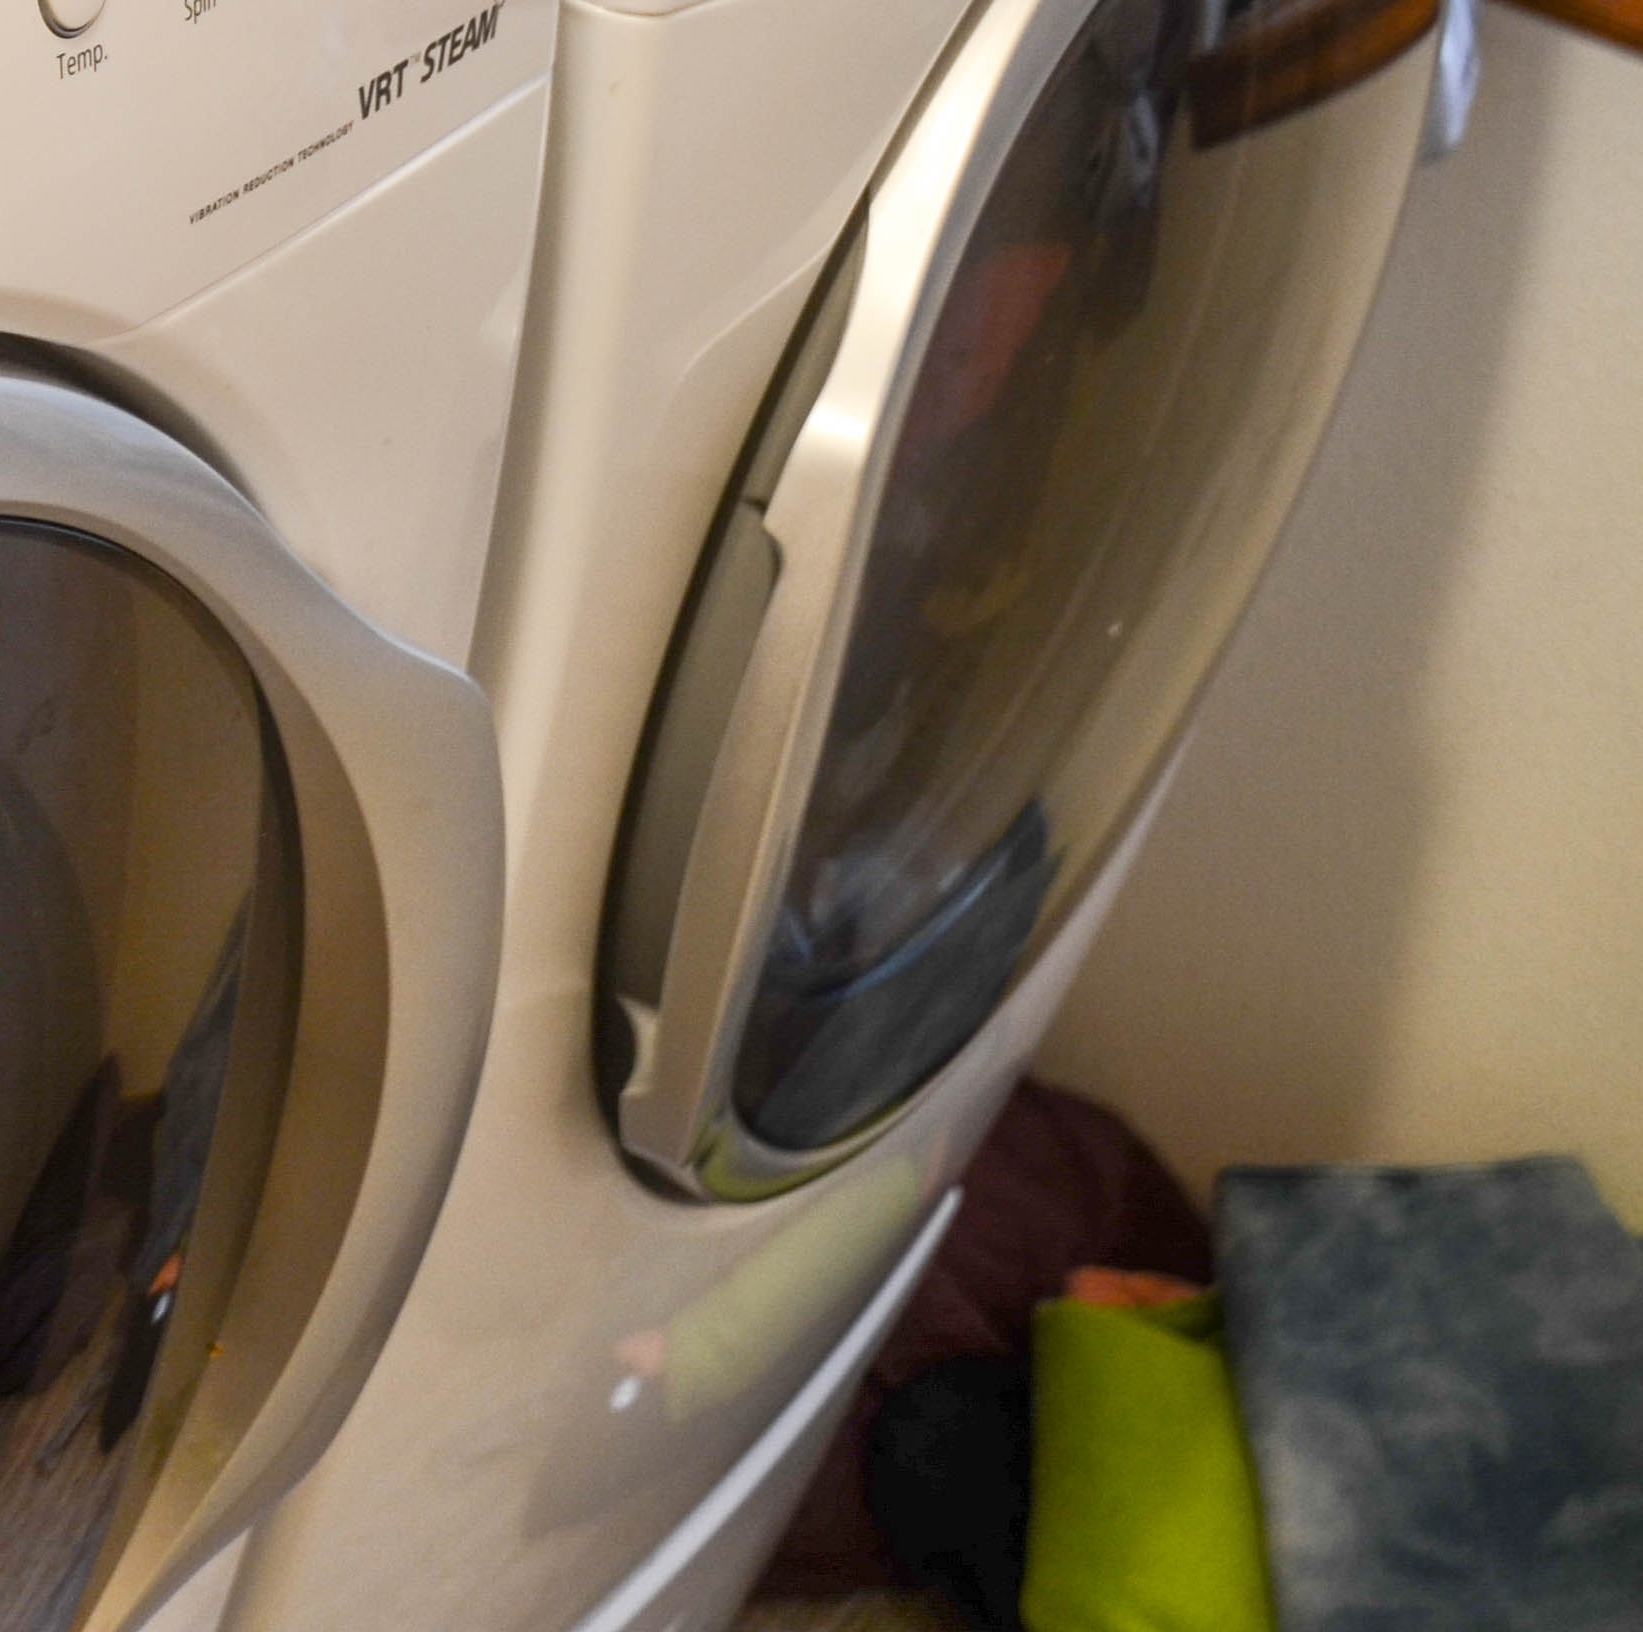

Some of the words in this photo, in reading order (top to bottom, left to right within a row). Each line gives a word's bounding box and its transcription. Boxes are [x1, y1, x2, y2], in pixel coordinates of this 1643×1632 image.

[56, 40, 110, 81] Temp.
[420, 4, 500, 85] STEAM
[188, 187, 241, 226] VIBRATION
[242, 156, 295, 196] REDUCTION
[297, 119, 355, 164] TECHNOLOGY
